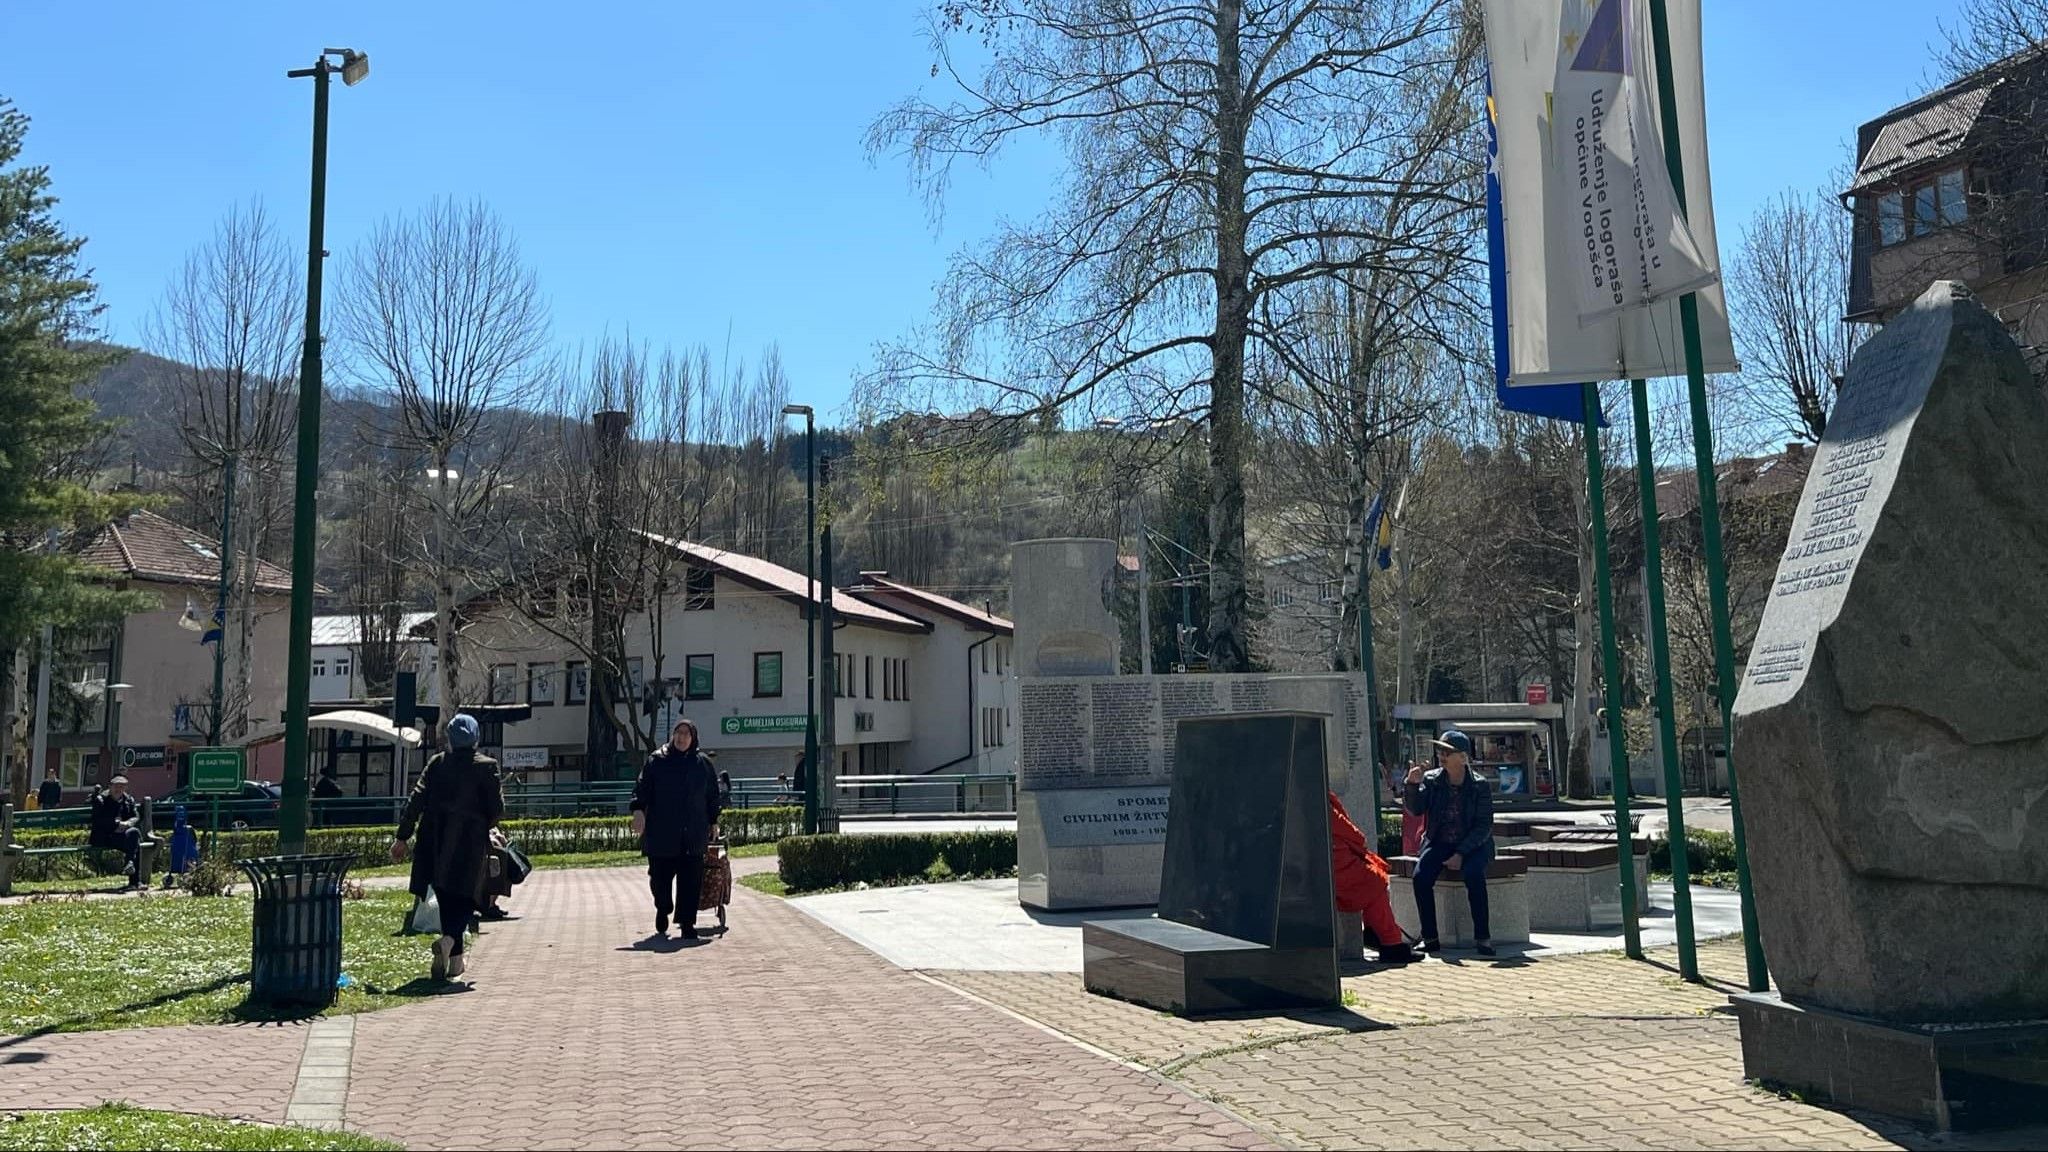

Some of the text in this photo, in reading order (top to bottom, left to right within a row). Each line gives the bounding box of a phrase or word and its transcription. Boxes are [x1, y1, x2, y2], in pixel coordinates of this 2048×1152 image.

[1574, 116, 1604, 289] općine Vogošća
[1591, 89, 1624, 306] Udruženje logoraša
[743, 717, 775, 728] CAMELIJA
[1117, 796, 1169, 807] SPOME
[1063, 813, 1130, 824] CIVILNIM
